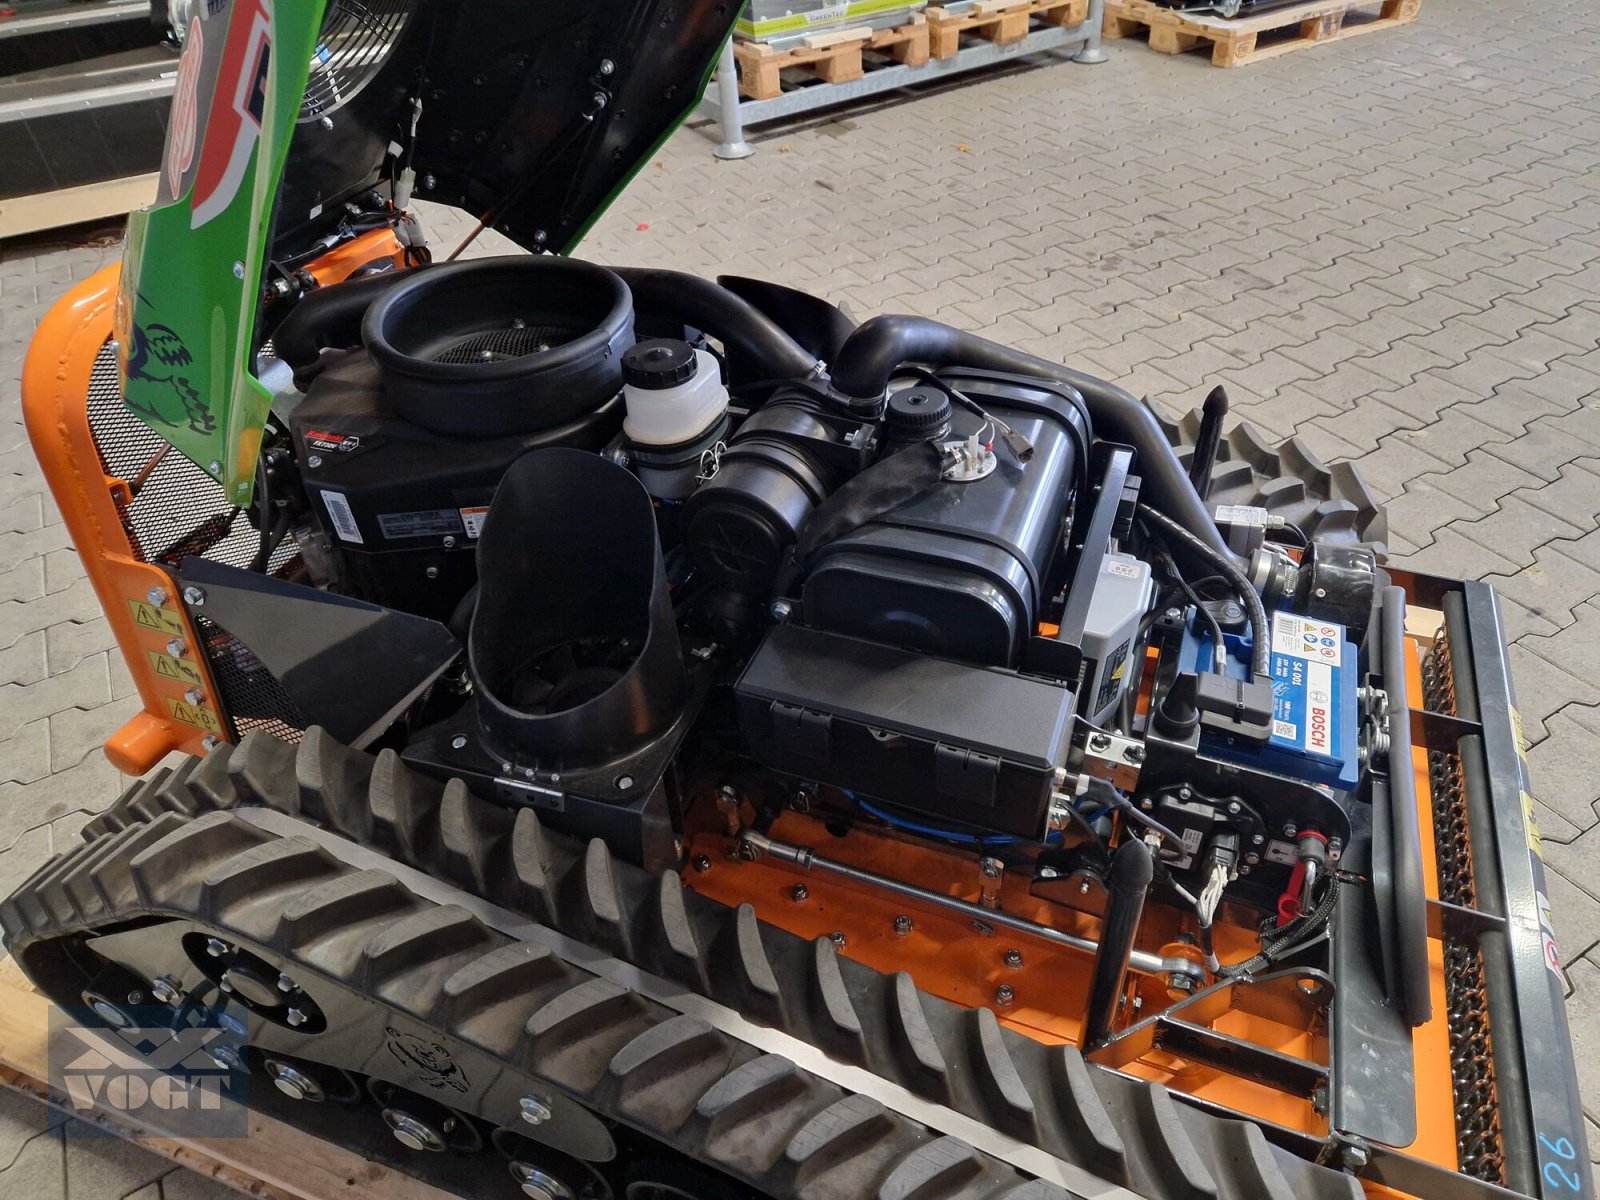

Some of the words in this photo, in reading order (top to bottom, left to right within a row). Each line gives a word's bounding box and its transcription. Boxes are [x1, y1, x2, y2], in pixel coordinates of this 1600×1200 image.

[1293, 661, 1303, 673] S4
[1292, 672, 1303, 686] 001
[1311, 706, 1326, 748] BOSCH
